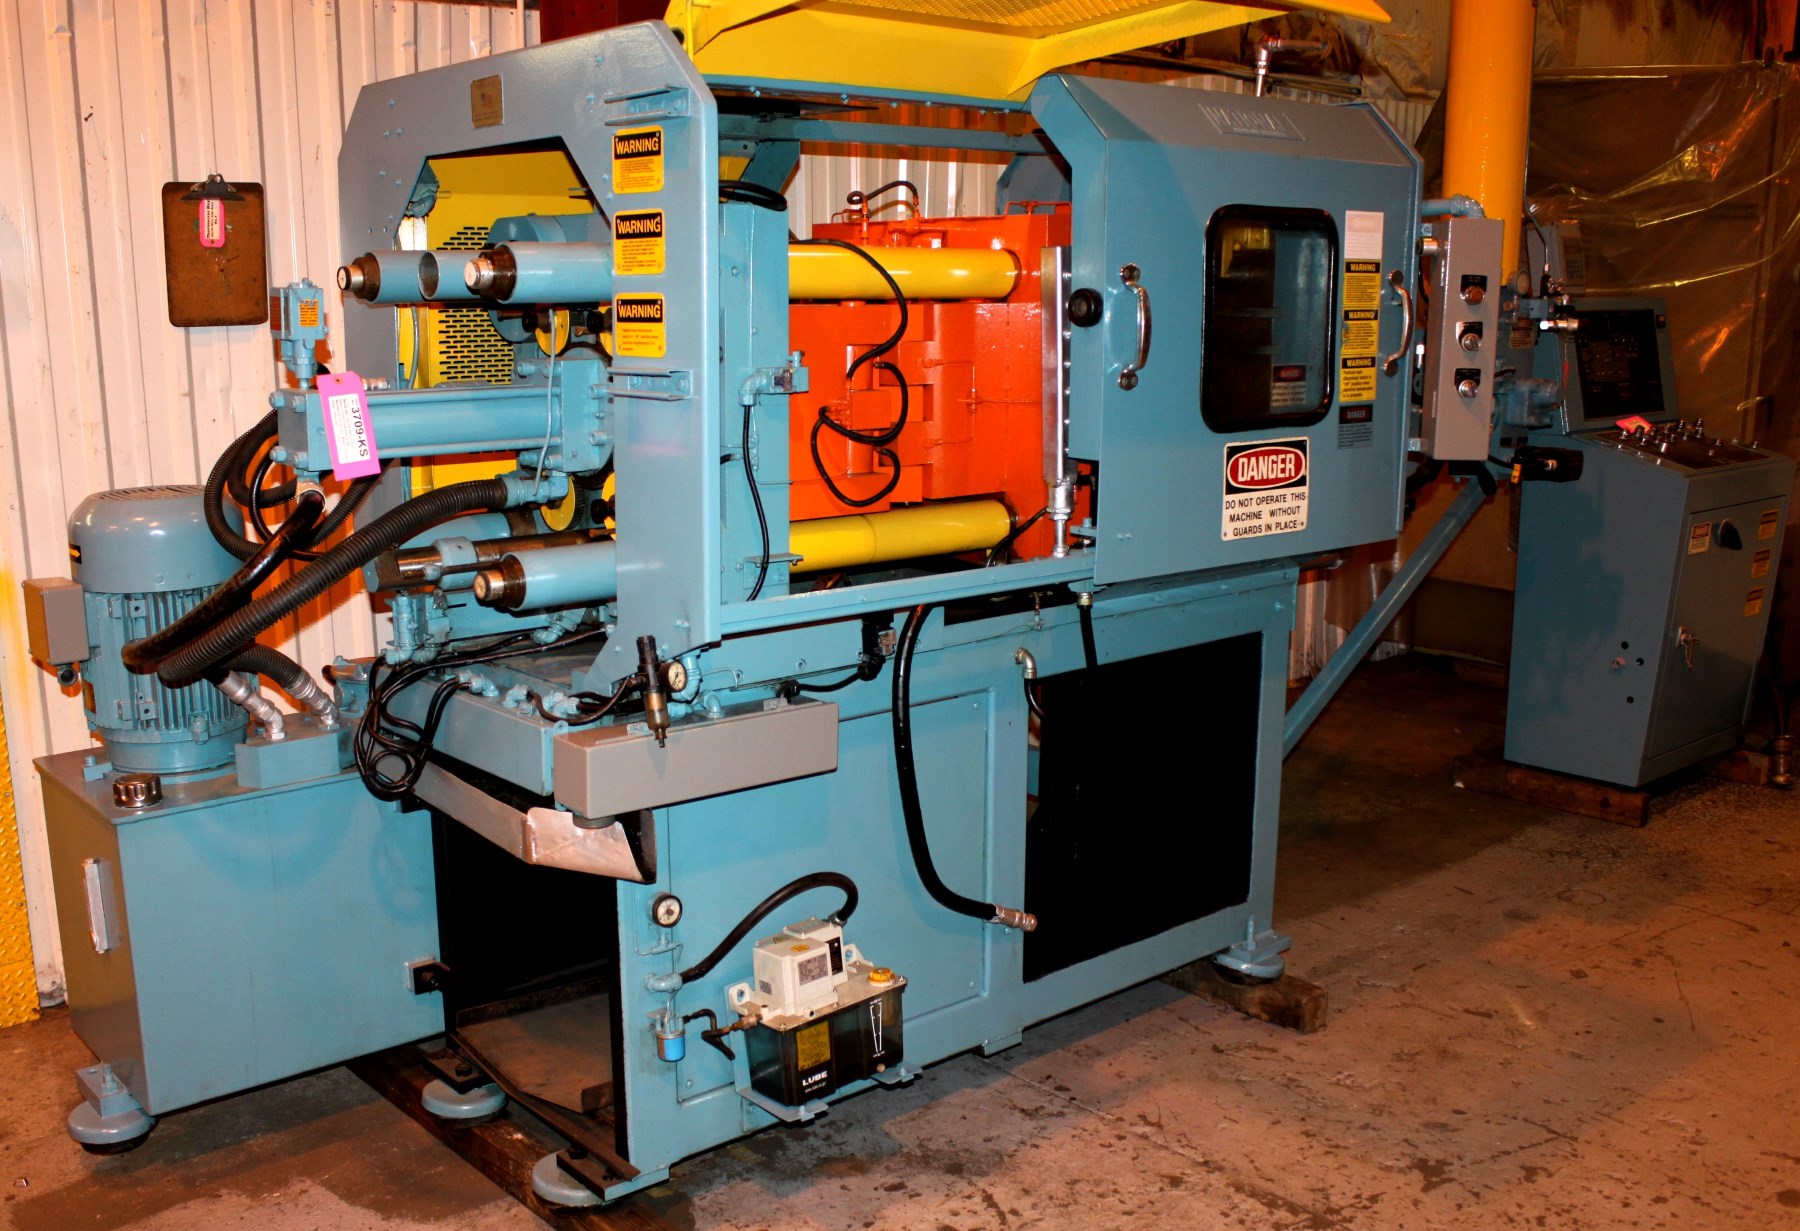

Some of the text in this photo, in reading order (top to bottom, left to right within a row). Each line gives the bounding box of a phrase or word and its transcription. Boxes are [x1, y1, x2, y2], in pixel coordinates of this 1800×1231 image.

[615, 137, 659, 155] WARNING
[617, 218, 661, 235] WARNING
[1350, 263, 1376, 272] WARNING
[617, 304, 661, 318] WARNING
[1348, 311, 1375, 319] WARNING
[1346, 359, 1372, 367] WARNING
[352, 407, 368, 457] 3709-KS
[1238, 453, 1295, 482] DANGER
[1225, 492, 1306, 510] DO NOT OPERATE THIS
[1229, 506, 1301, 523] MACHINE WITHOUT
[1233, 520, 1297, 537] GUARDS IN PLACE
[802, 1070, 828, 1087] LUBE
